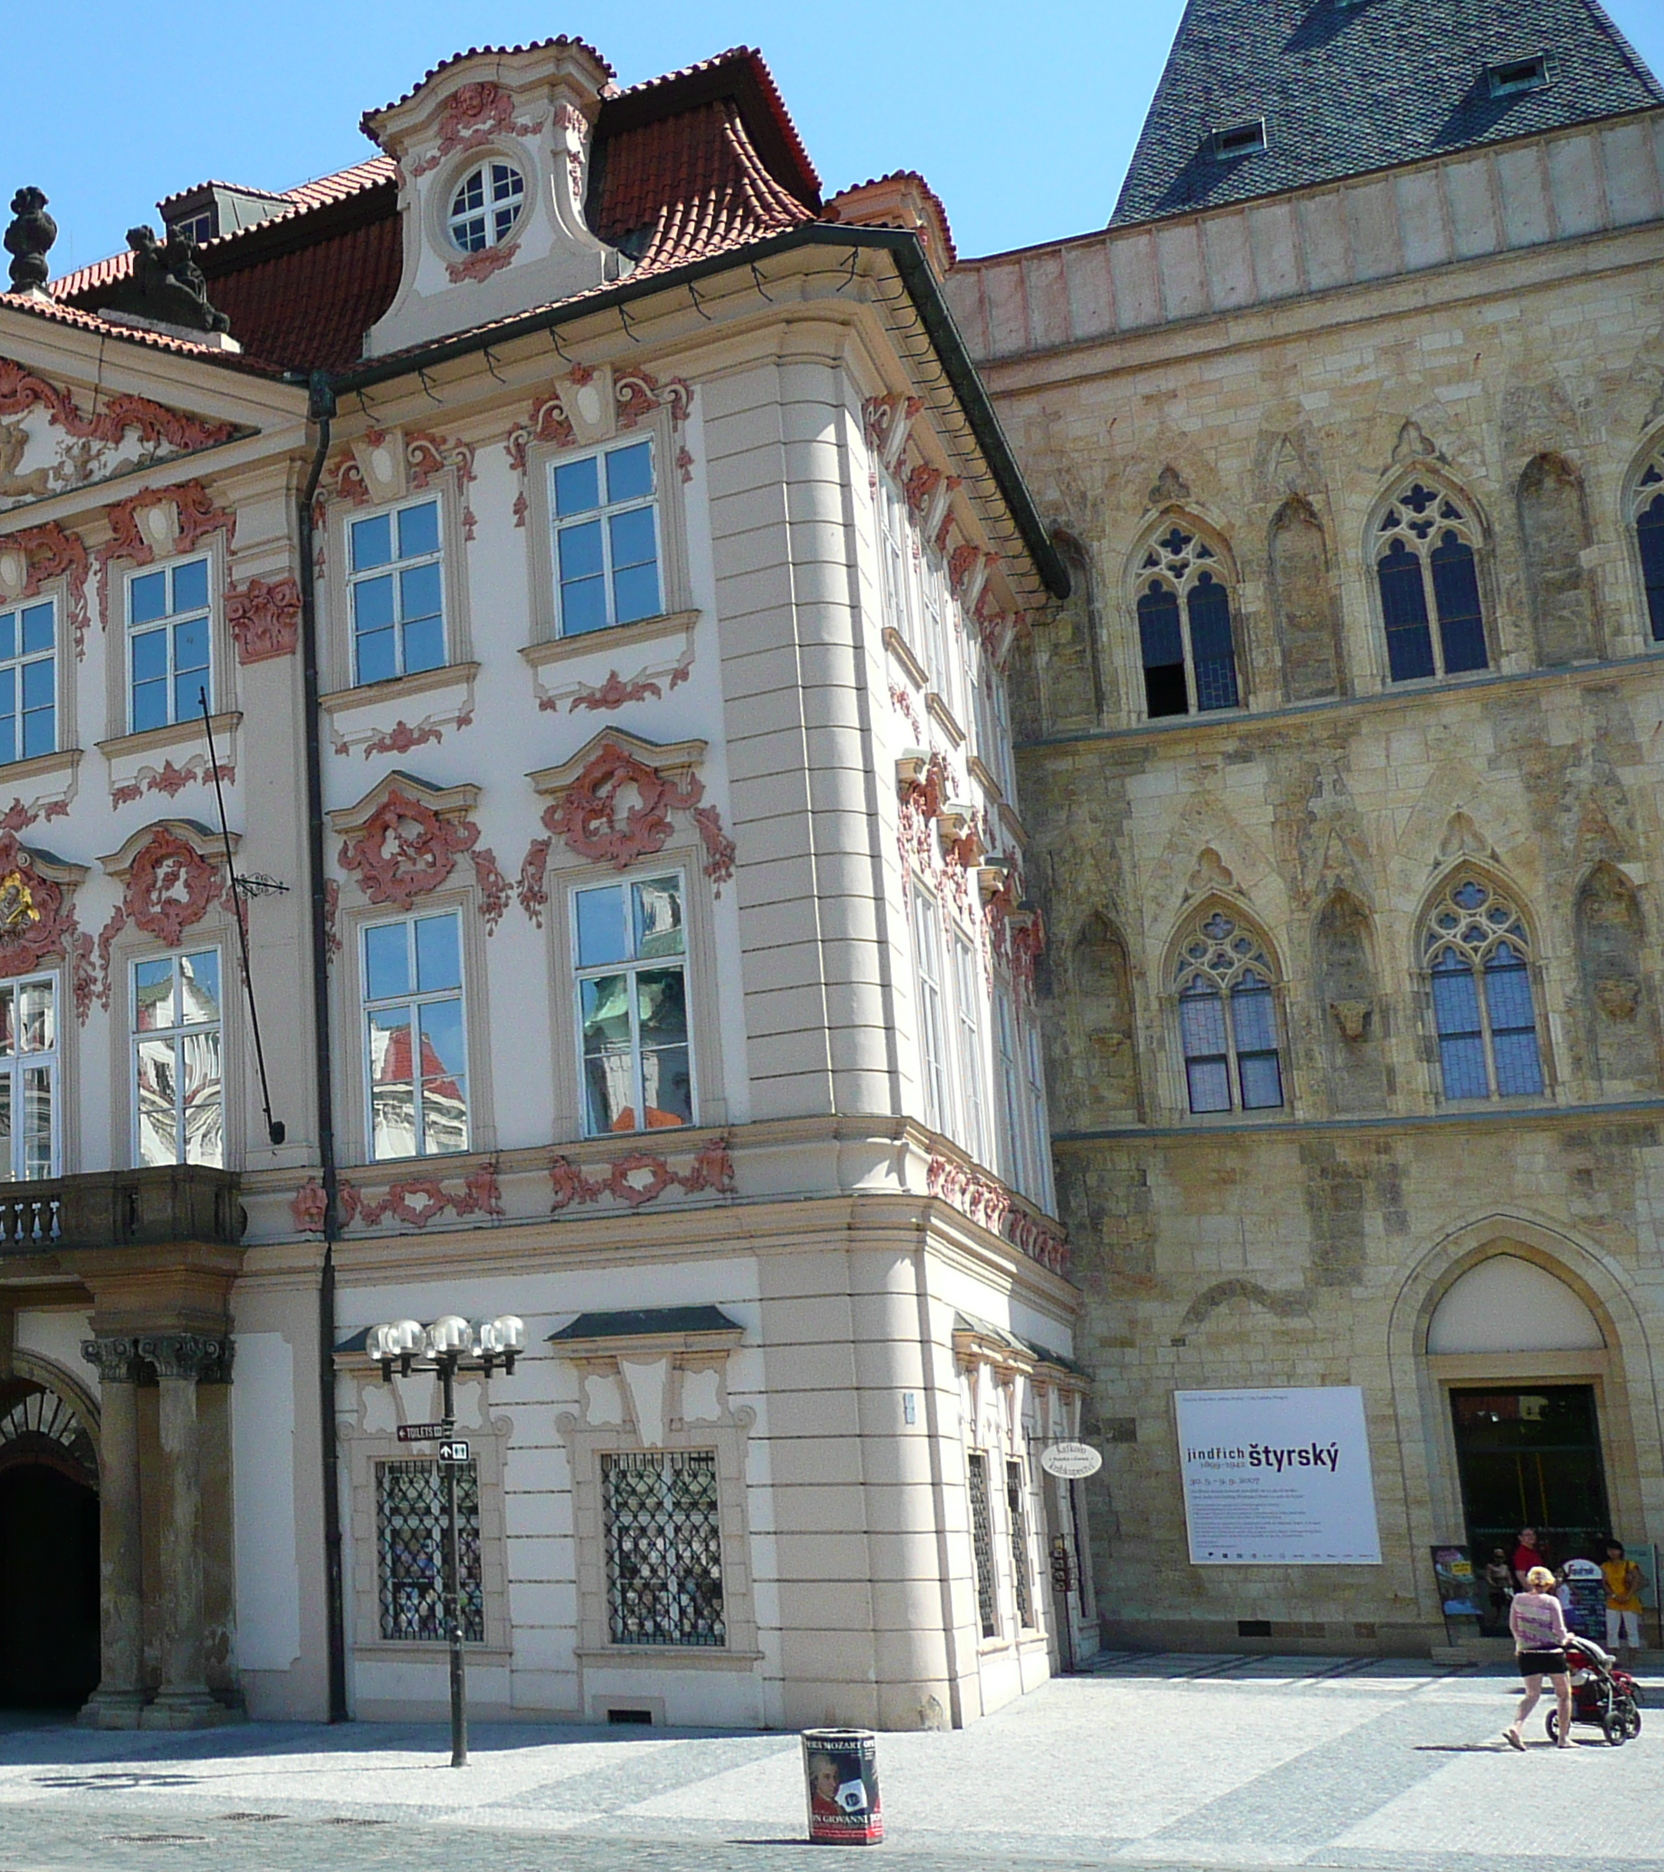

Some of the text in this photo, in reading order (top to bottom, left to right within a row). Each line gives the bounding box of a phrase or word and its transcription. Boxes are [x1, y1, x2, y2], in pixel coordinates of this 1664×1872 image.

[406, 1427, 433, 1438] TOILETS
[1187, 1441, 1339, 1473] jindřich štyrský
[823, 1740, 861, 1750] MOZART
[822, 1814, 868, 1824] GIOVANNI
